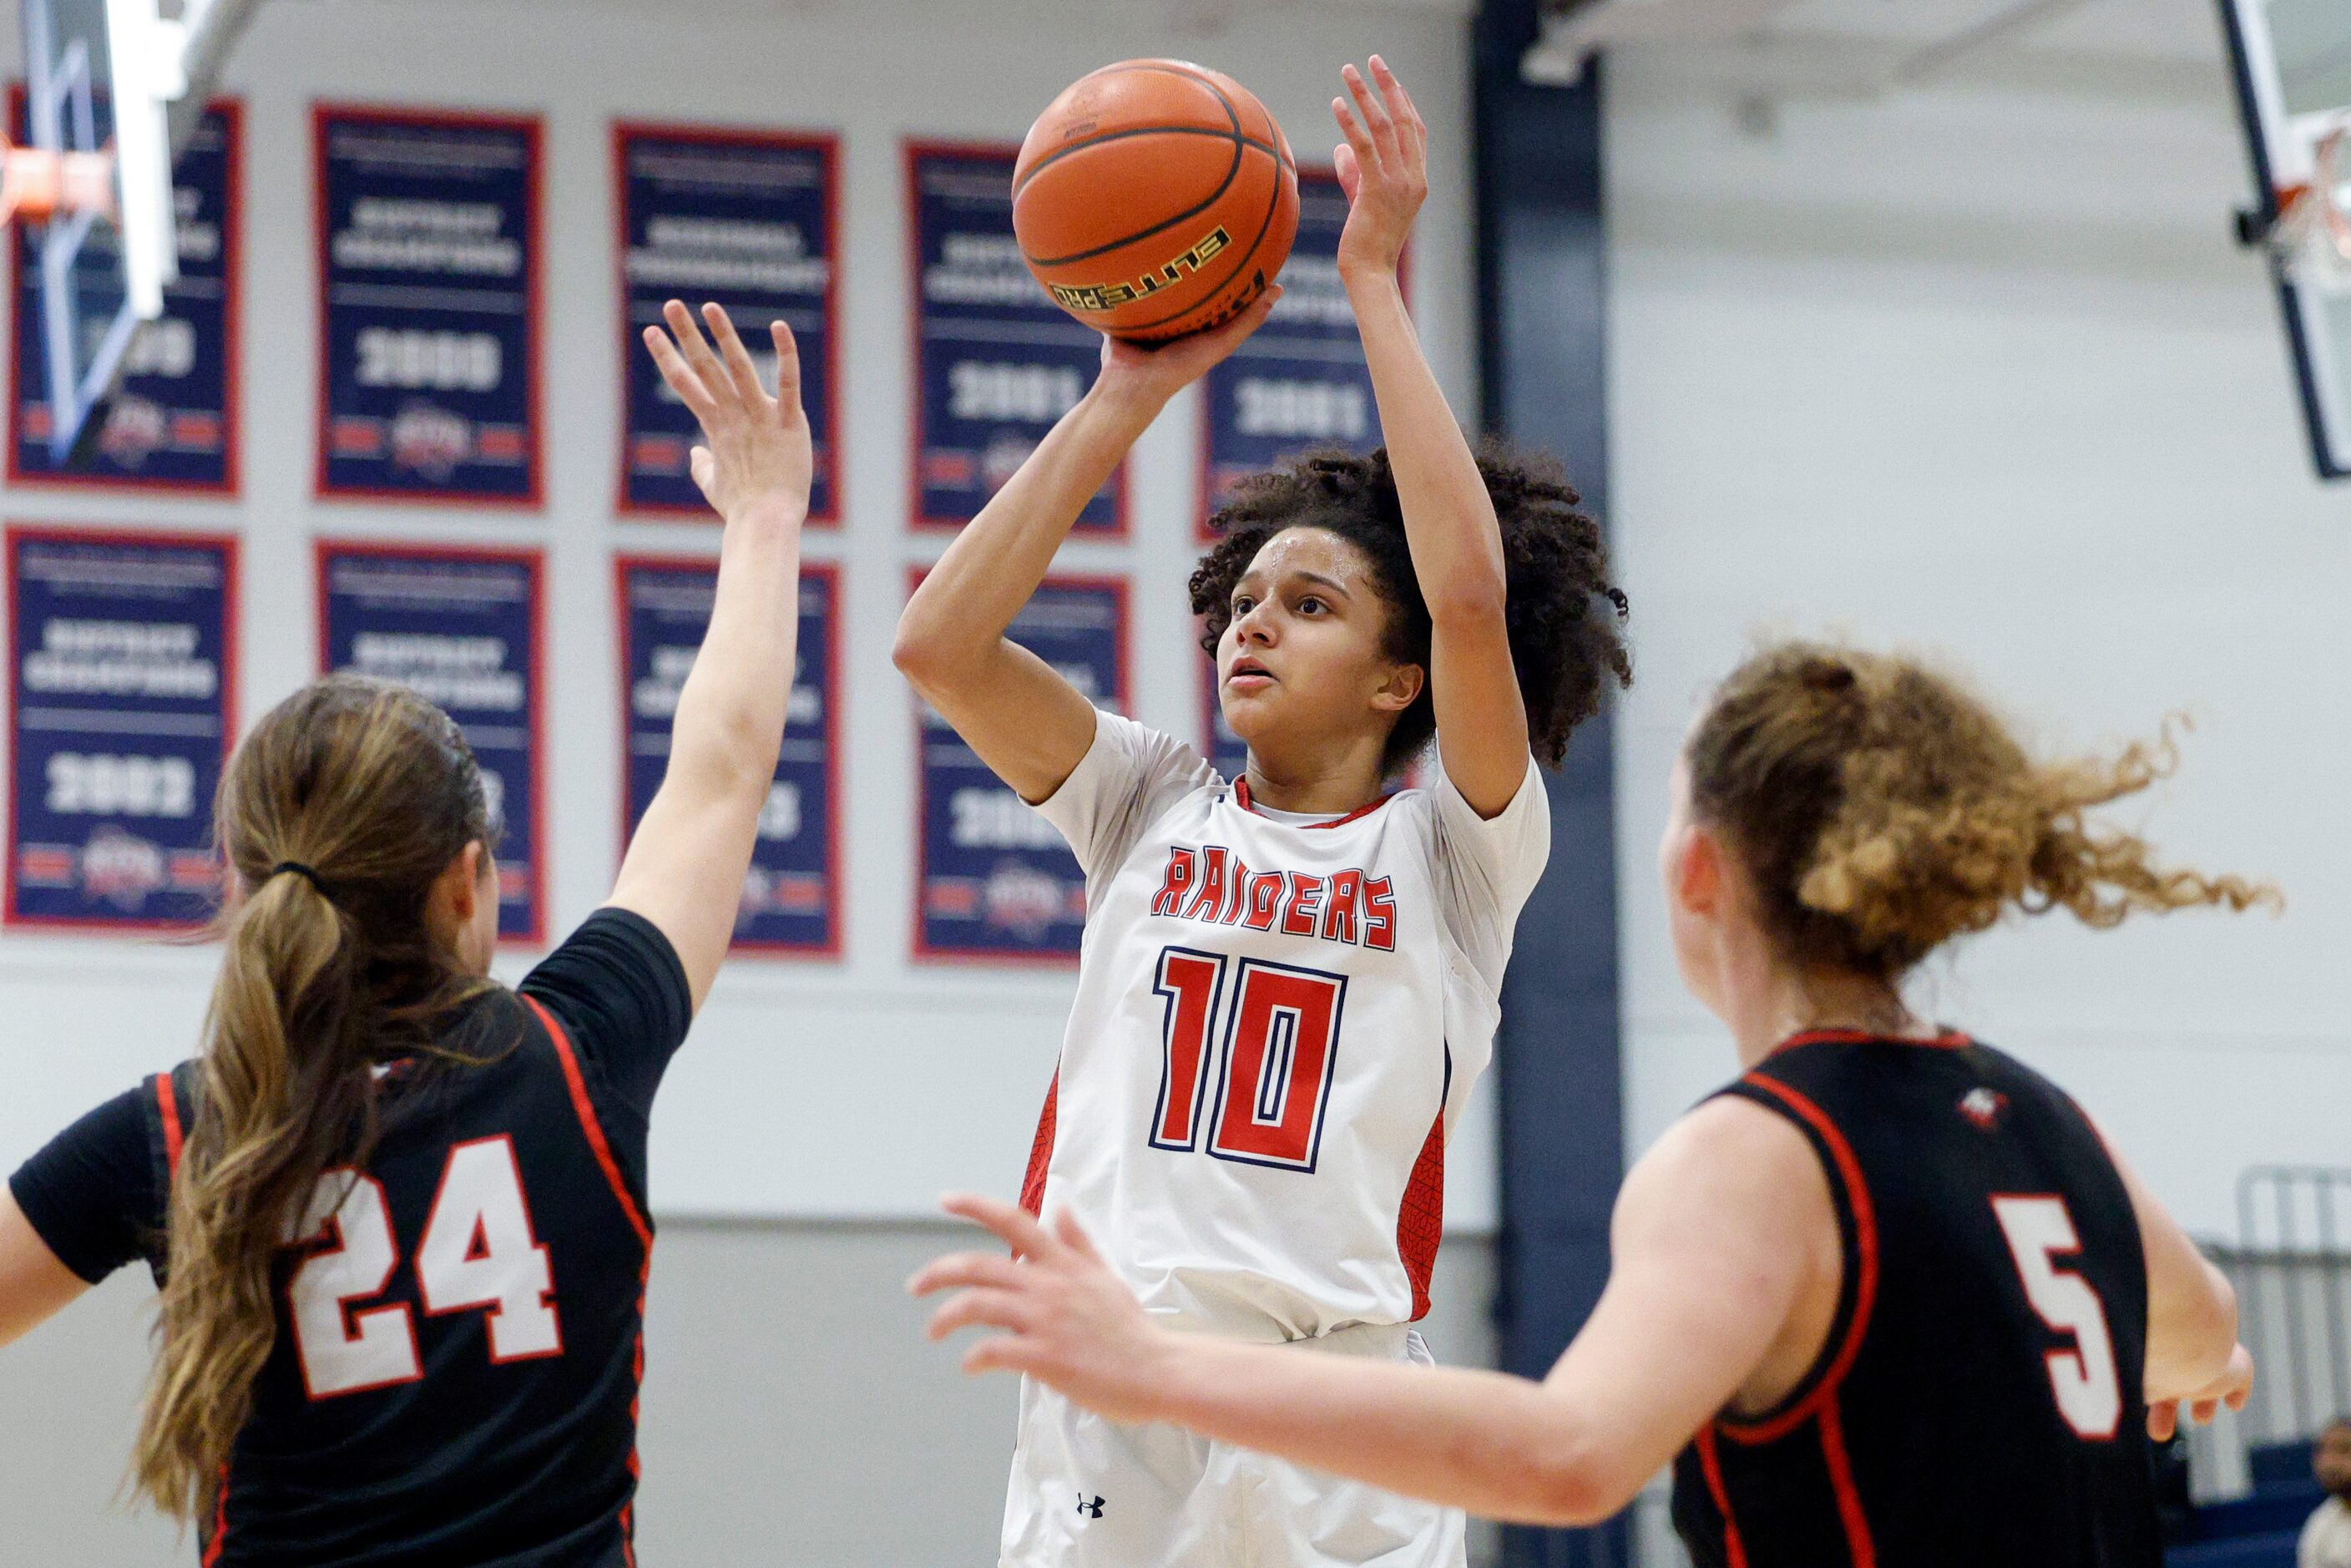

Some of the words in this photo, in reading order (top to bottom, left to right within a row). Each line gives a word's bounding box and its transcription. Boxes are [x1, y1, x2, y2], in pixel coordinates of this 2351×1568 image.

[1049, 283, 1102, 311] PRO
[1098, 224, 1232, 306] ELITE
[1150, 846, 1397, 953] RAIDERS
[1148, 945, 1349, 1175] 10
[280, 1132, 564, 1402] 24
[1987, 1192, 2124, 1442] 5
